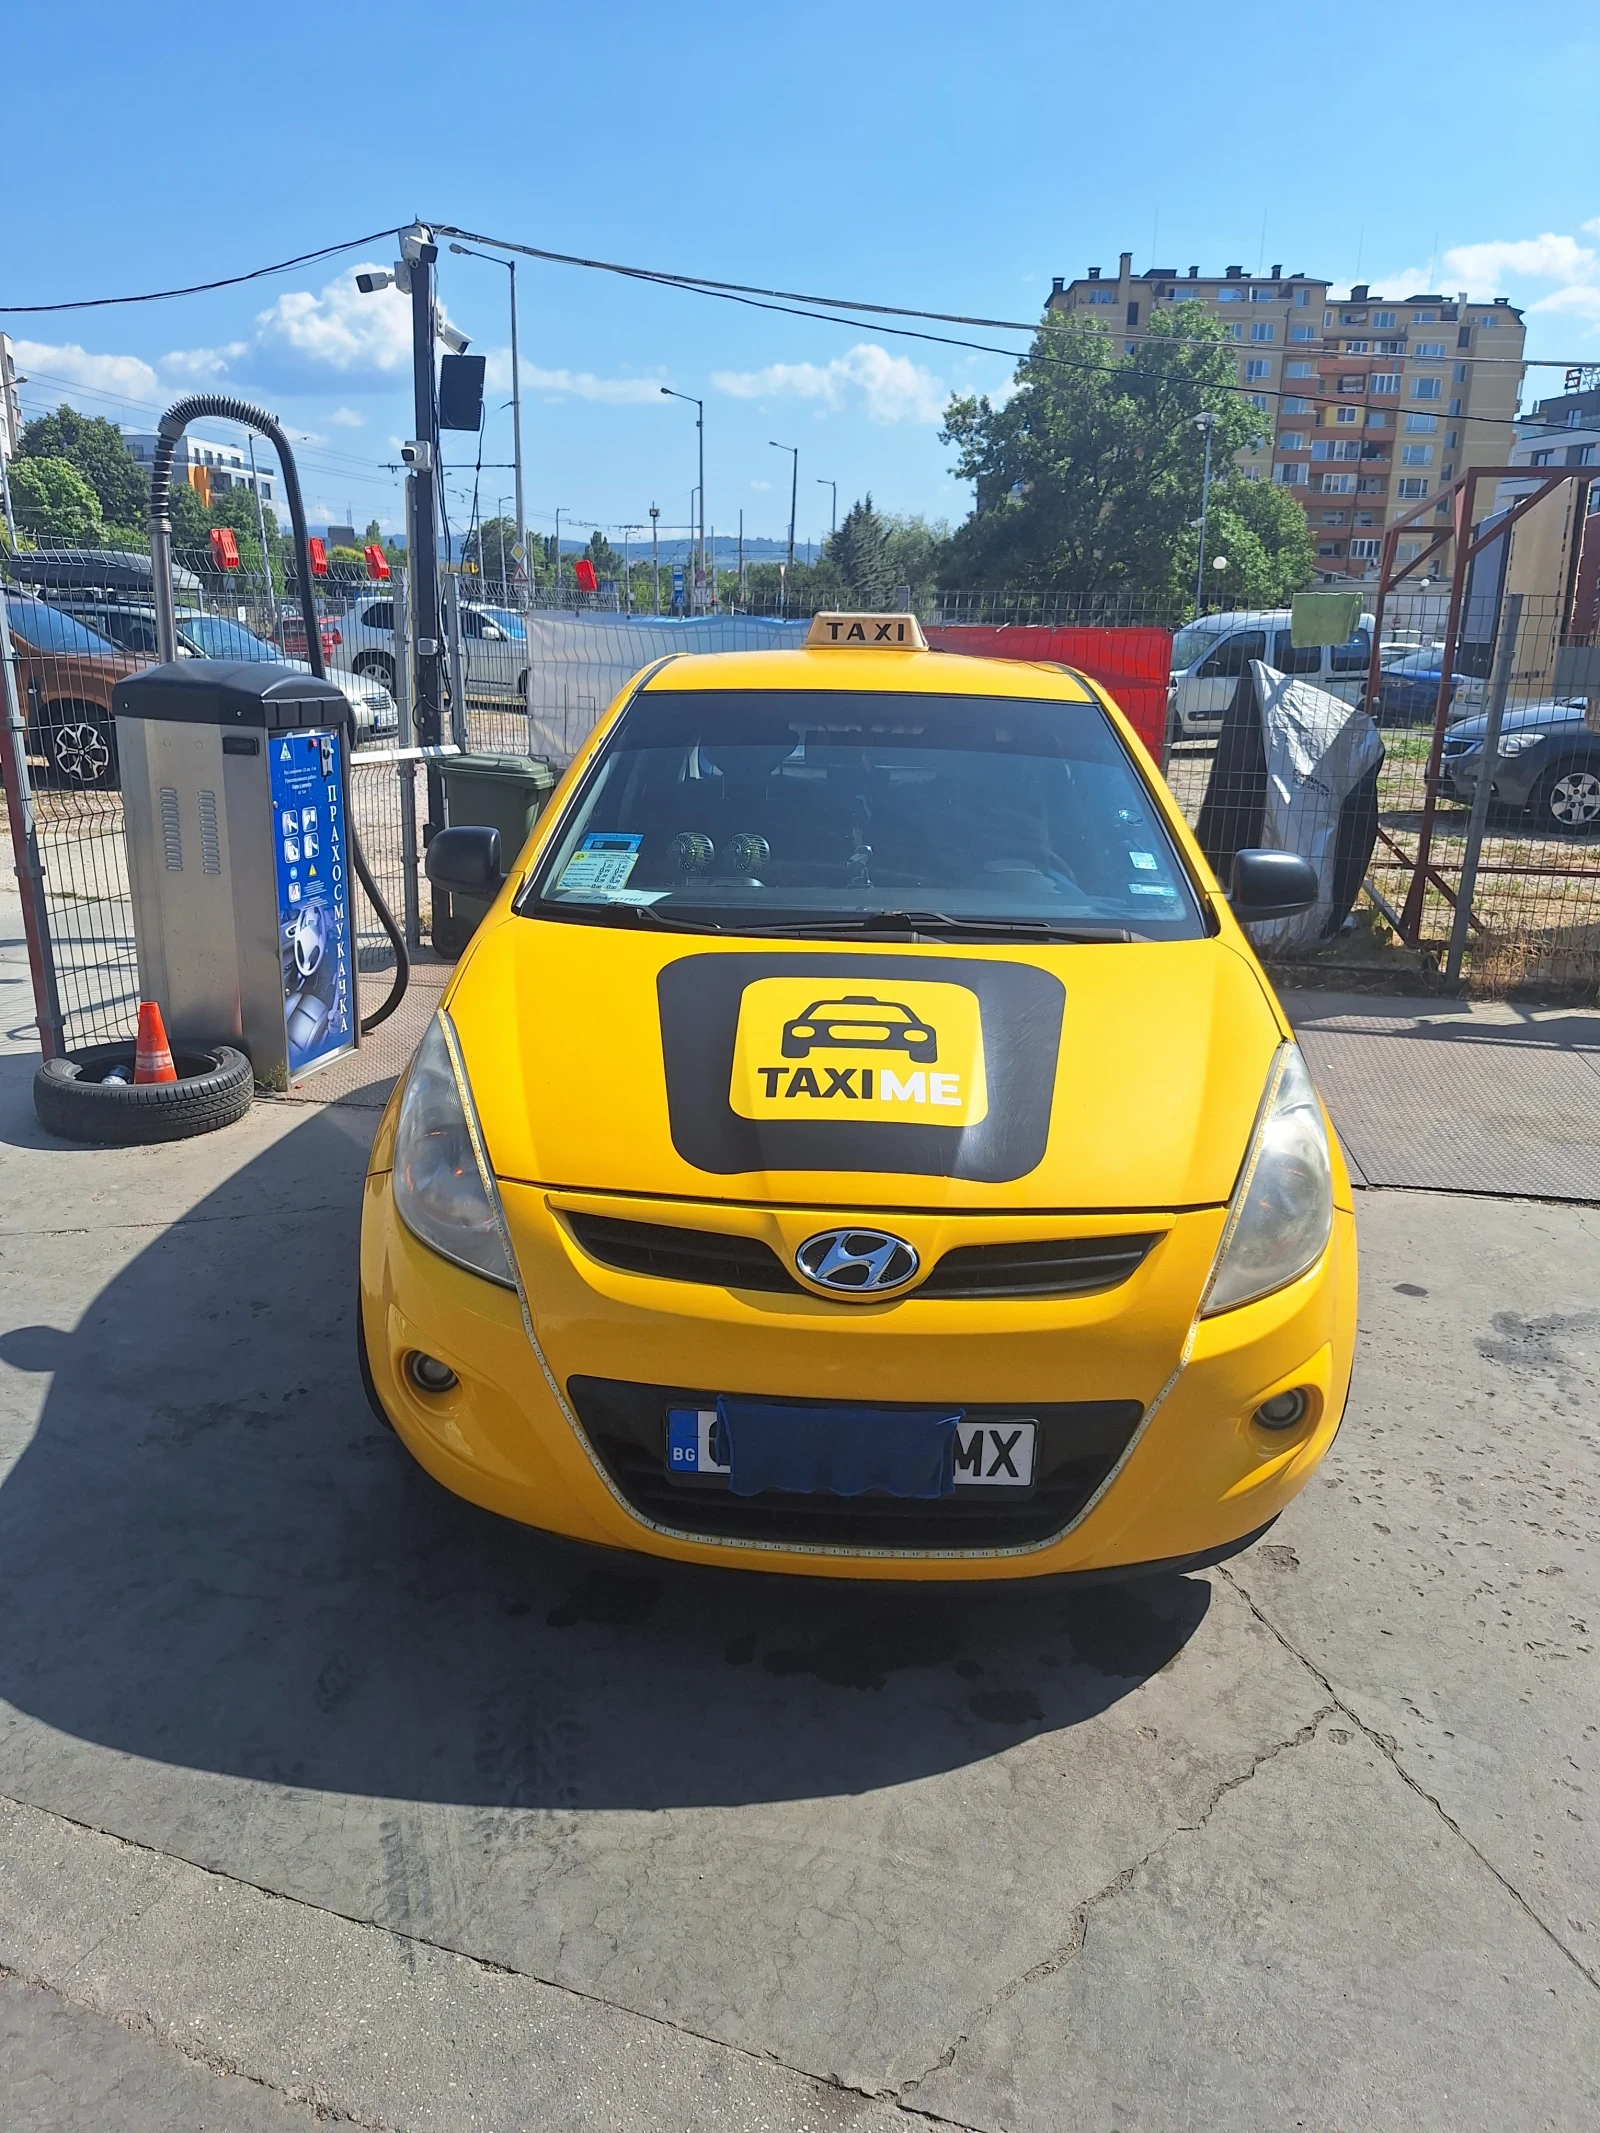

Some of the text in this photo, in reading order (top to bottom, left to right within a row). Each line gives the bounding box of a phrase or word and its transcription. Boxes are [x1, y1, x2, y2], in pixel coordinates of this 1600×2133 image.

[826, 622, 904, 641] TAXI
[328, 785, 348, 1034] ПРАХОСМУКАЧКА
[672, 1430, 1022, 1478] BG MX
